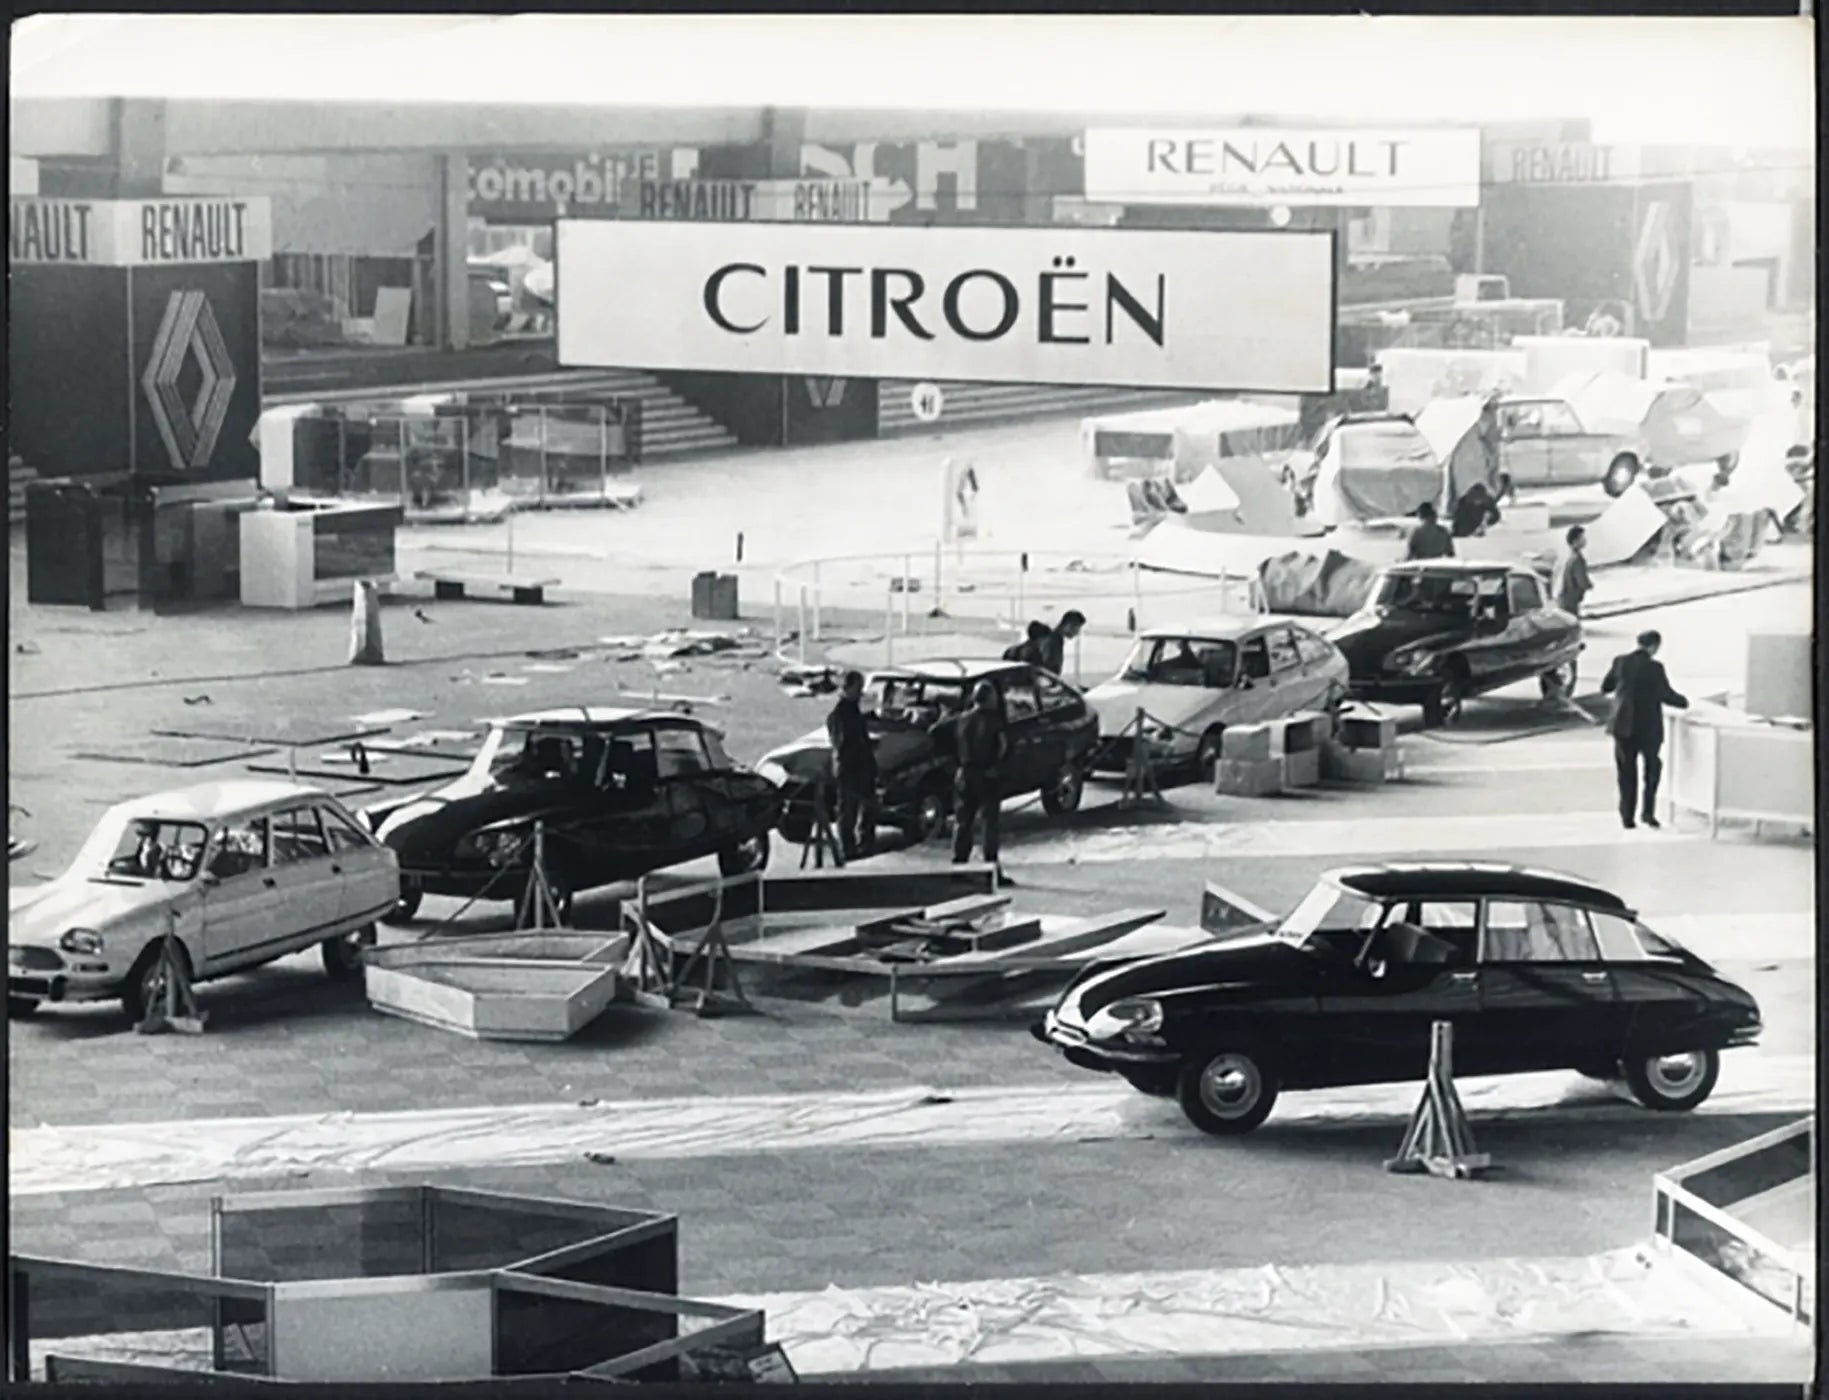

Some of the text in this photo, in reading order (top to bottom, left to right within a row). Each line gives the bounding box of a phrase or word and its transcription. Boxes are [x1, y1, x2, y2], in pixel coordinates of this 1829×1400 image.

[1147, 139, 1409, 176] RENAULT
[1511, 145, 1614, 182] RENAULT
[641, 182, 756, 219] RENAULT
[142, 203, 246, 259] RENAULT
[703, 256, 1165, 347] CITROËN
